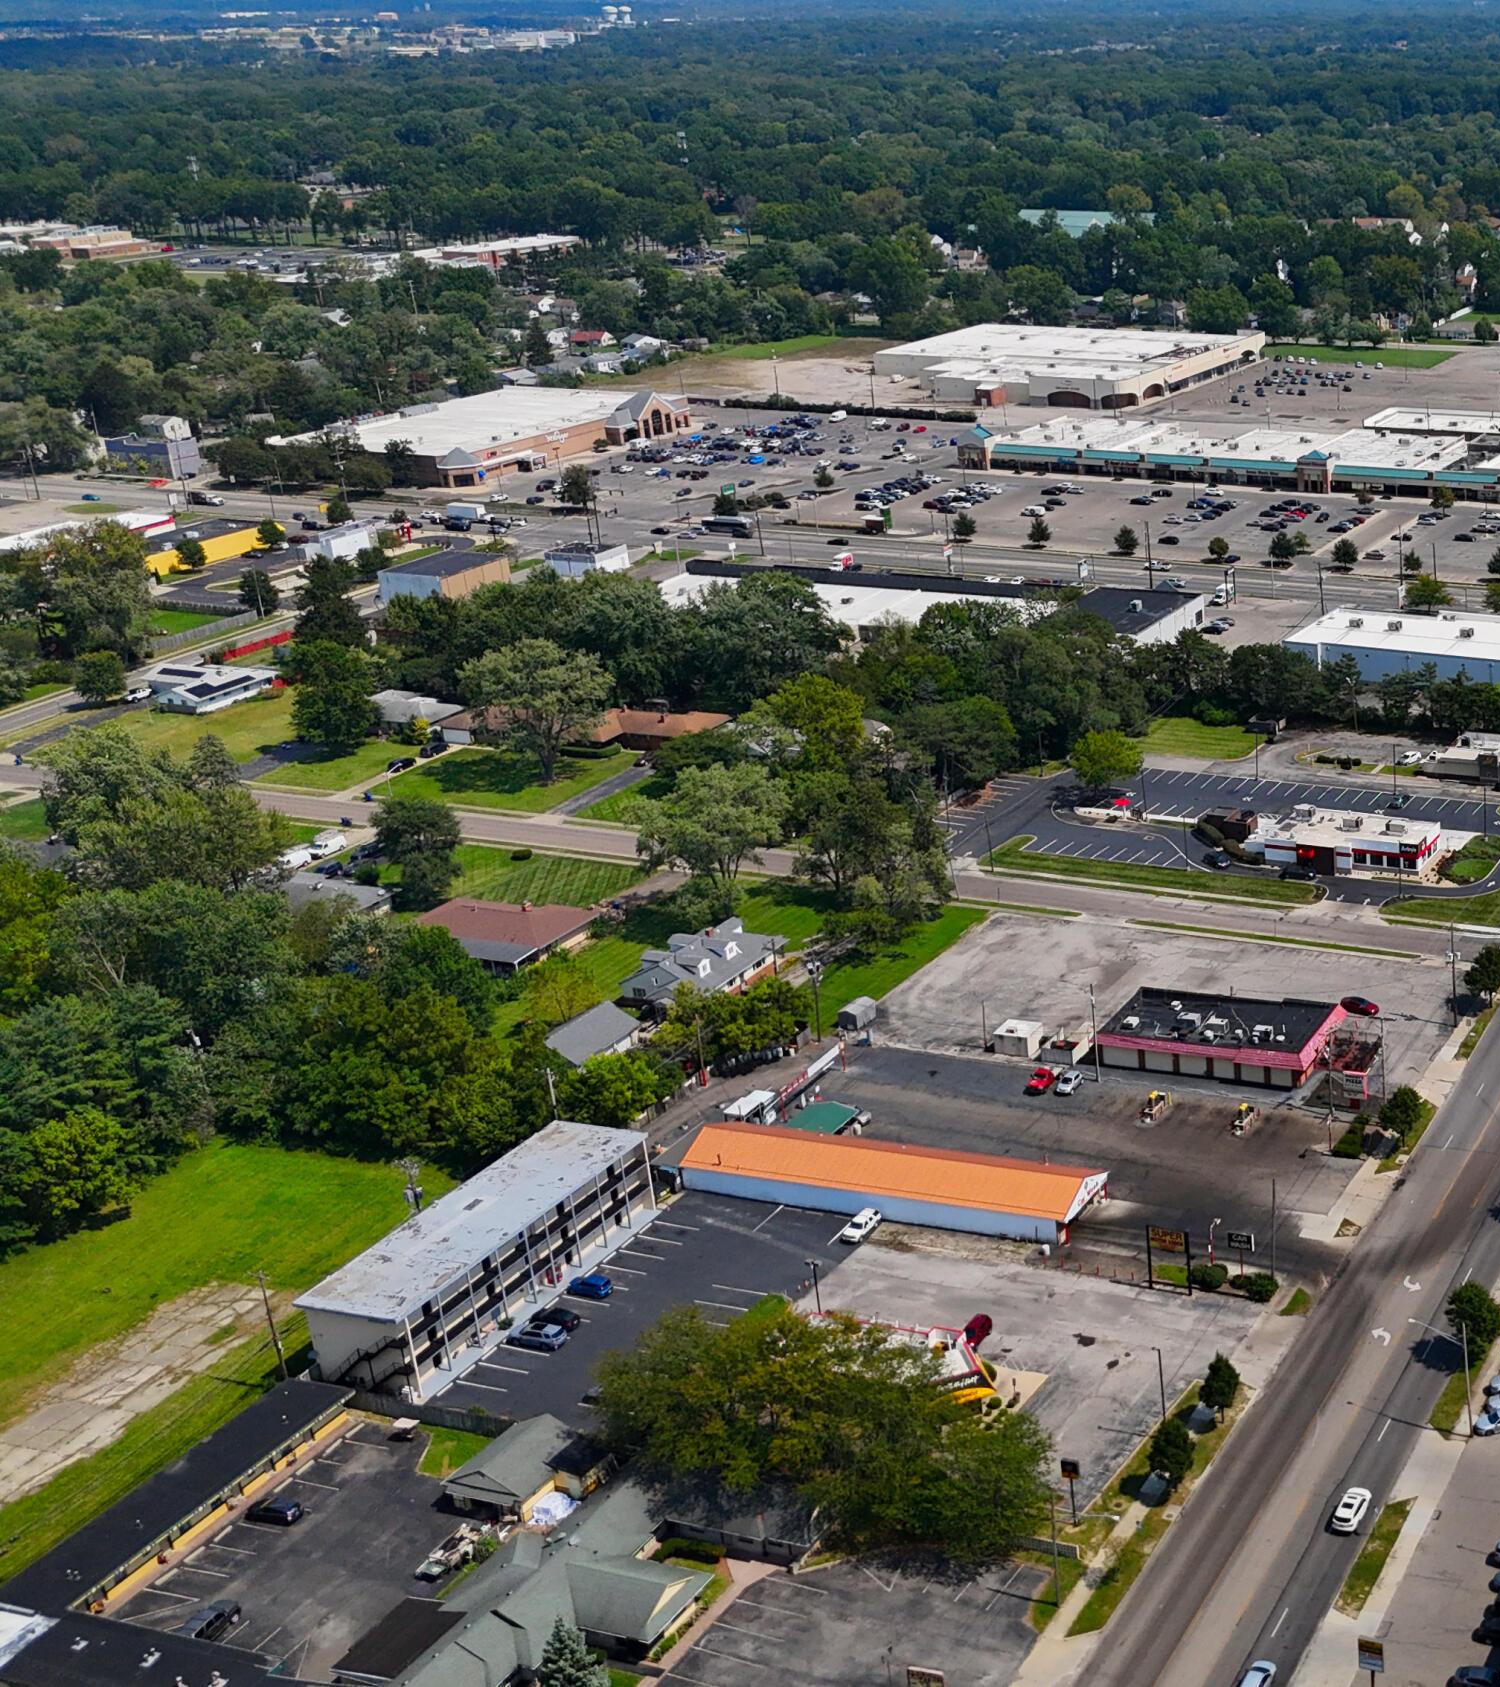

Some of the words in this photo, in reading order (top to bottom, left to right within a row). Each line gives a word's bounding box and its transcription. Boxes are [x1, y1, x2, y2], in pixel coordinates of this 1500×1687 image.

[1151, 1228, 1183, 1240] SUPER
[1231, 1234, 1248, 1242] CAR
[1230, 1241, 1251, 1249] WASH
